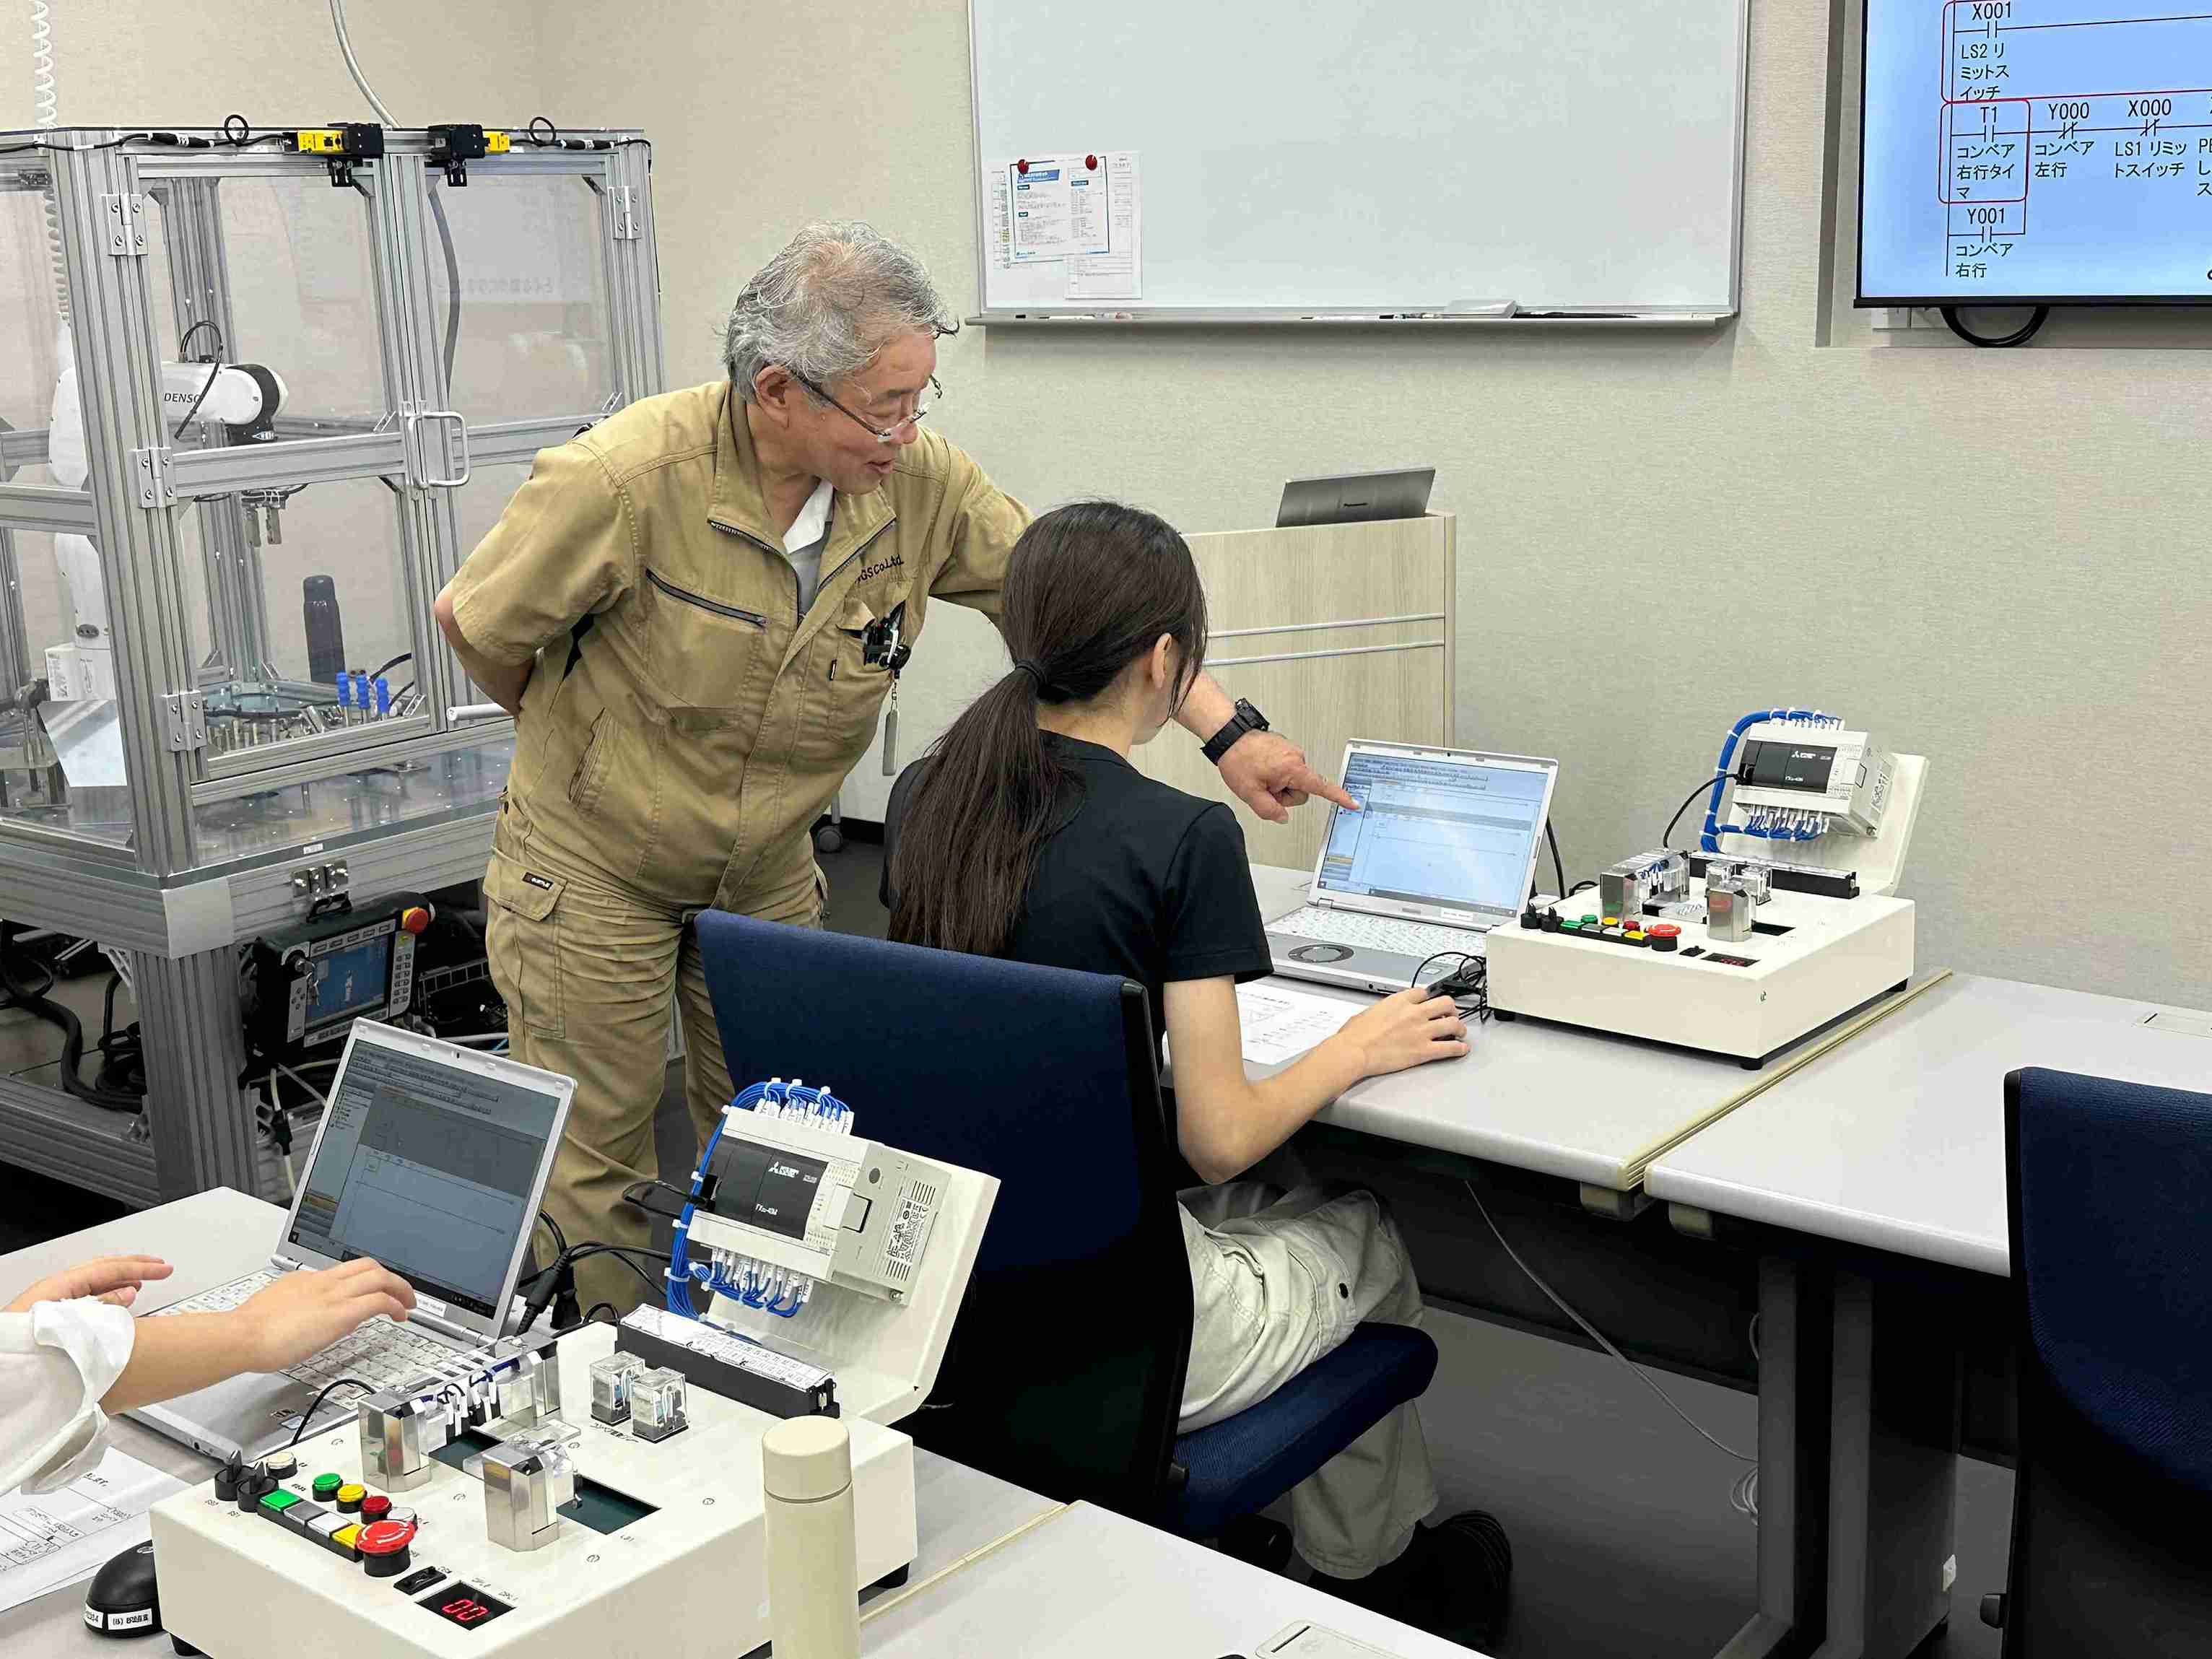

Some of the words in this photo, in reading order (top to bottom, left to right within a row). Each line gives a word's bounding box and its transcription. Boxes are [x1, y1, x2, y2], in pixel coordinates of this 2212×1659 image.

[1972, 1, 2011, 20] X001
[1961, 64, 2010, 80] ミットス
[1960, 86, 2000, 101] イッチ
[1980, 106, 1997, 123] T1
[2048, 102, 2090, 120] Y000
[2128, 98, 2172, 117] X000
[1957, 143, 2016, 159] コンベア
[2035, 139, 2095, 156] コンベア
[1957, 163, 2015, 180] 右行タイ
[2035, 161, 2068, 178] 左行
[2115, 162, 2185, 178] トスイッチ
[1956, 187, 1970, 199] マ
[1967, 207, 2005, 225] Y001
[1956, 243, 2013, 257] コンベア
[1955, 263, 1987, 278] 右行
